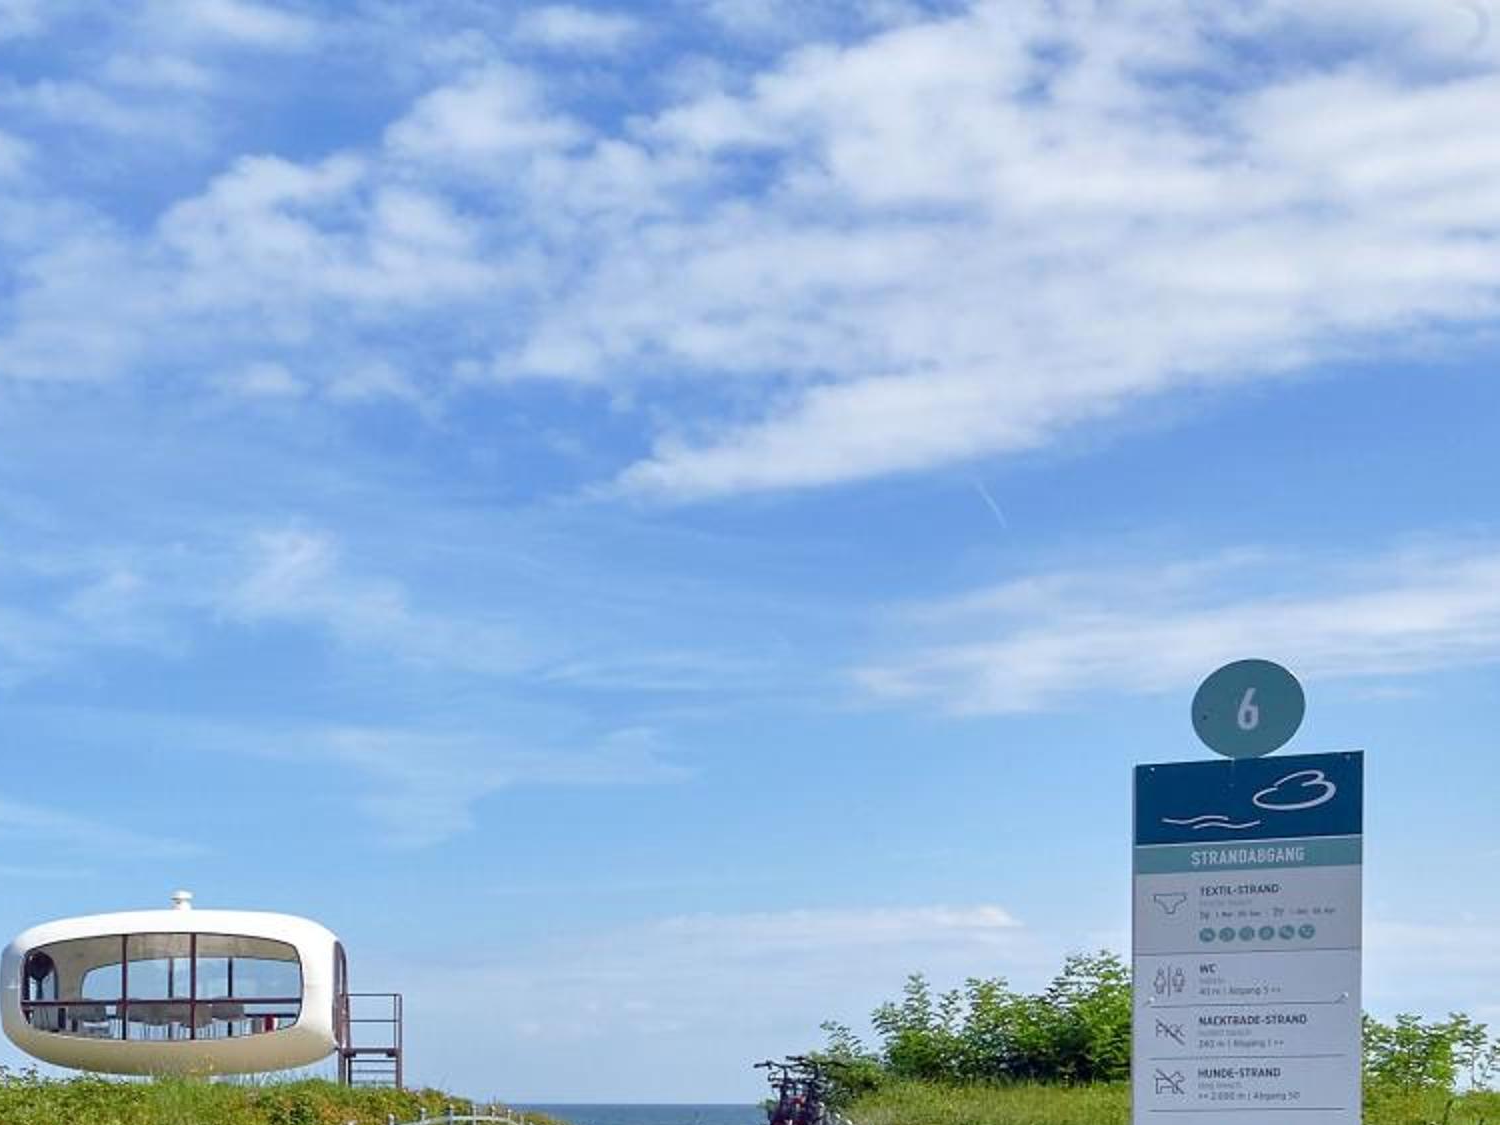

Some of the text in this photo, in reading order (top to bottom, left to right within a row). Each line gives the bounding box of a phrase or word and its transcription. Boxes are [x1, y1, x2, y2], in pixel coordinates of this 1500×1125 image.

[1237, 687, 1259, 730] 6
[1190, 847, 1306, 865] STRANDABGANG
[1200, 883, 1280, 897] TEXTIL-STRAND
[1199, 963, 1217, 974] WC
[1197, 1067, 1281, 1079] HUNDE-STRAND
